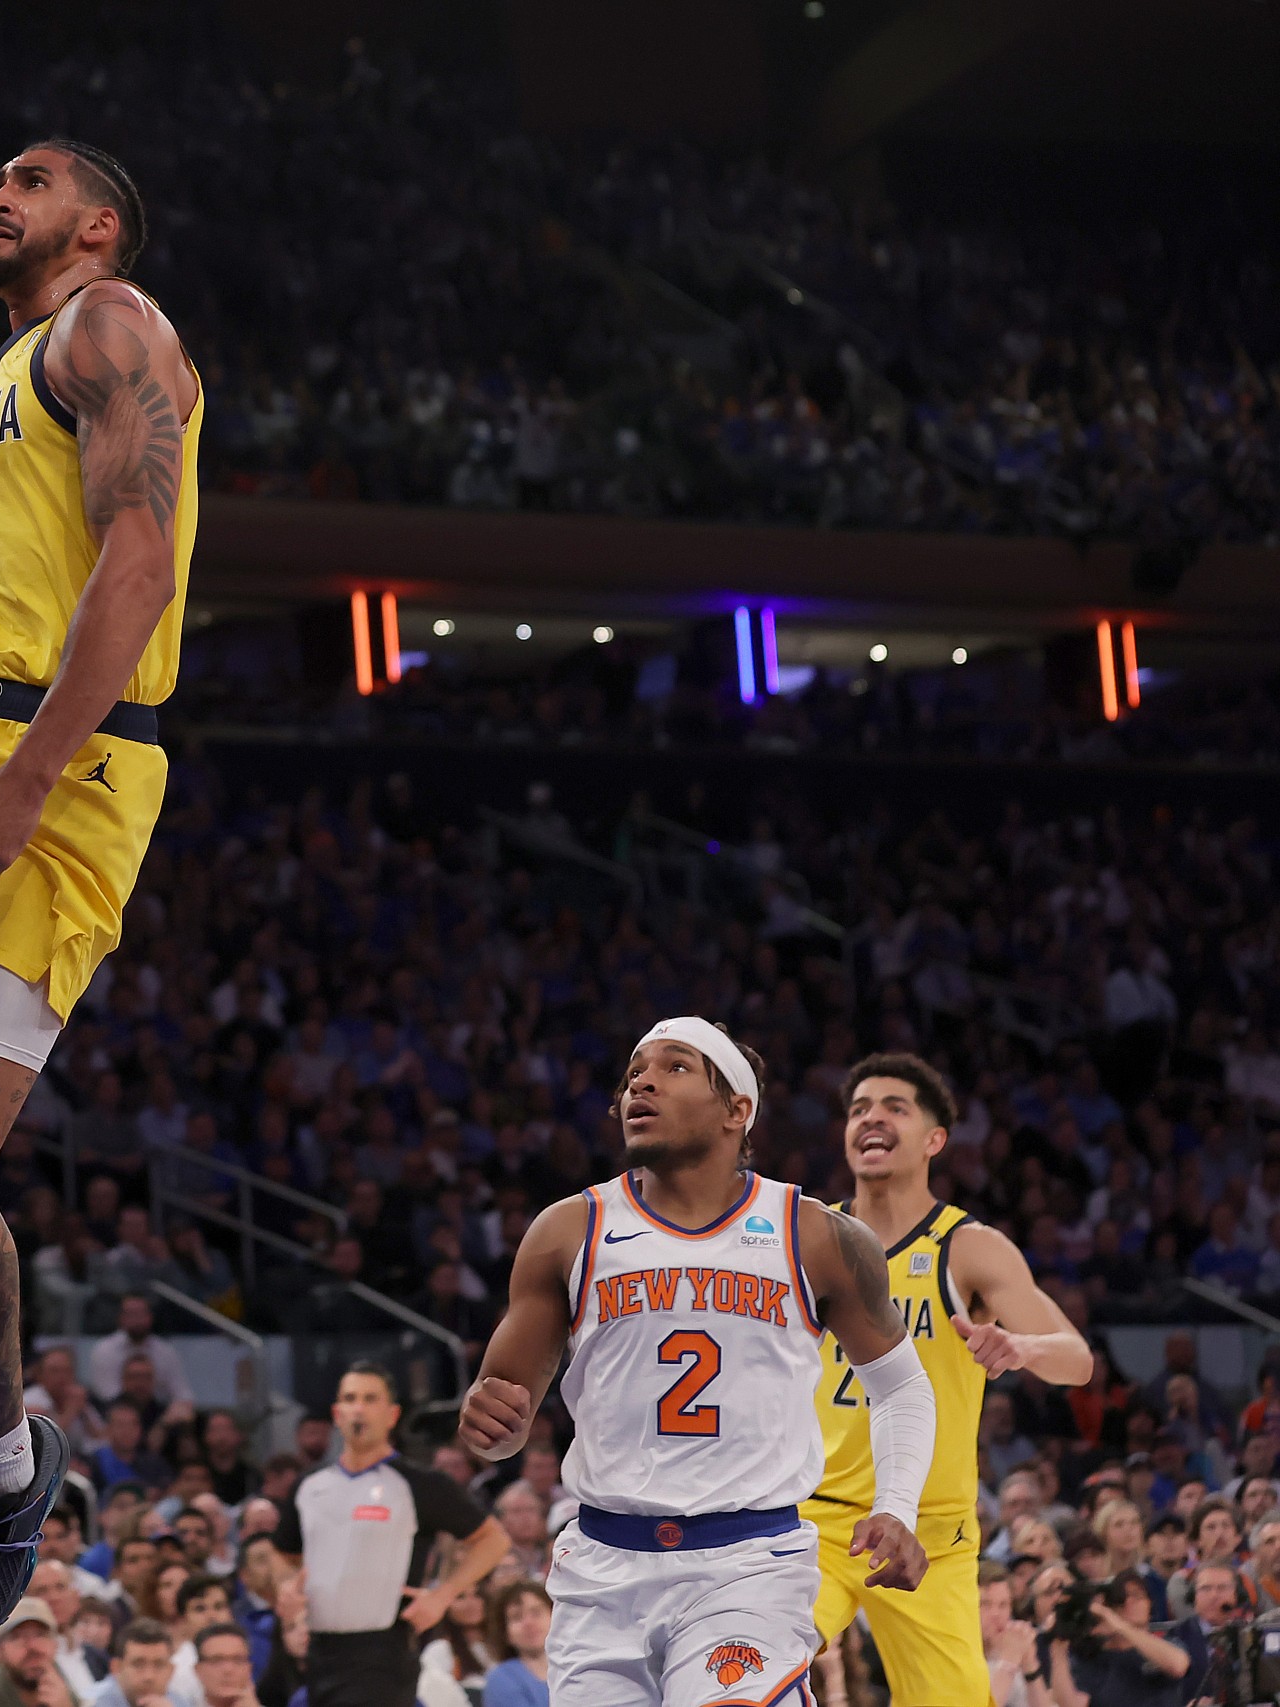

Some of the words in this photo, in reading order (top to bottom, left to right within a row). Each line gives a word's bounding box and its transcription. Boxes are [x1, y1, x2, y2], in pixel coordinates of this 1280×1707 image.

[740, 1235, 780, 1248] sphere
[595, 1267, 682, 1325] NEW
[685, 1267, 790, 1328] YORK
[657, 1329, 722, 1438] 2
[706, 1646, 763, 1673] KNICKS
